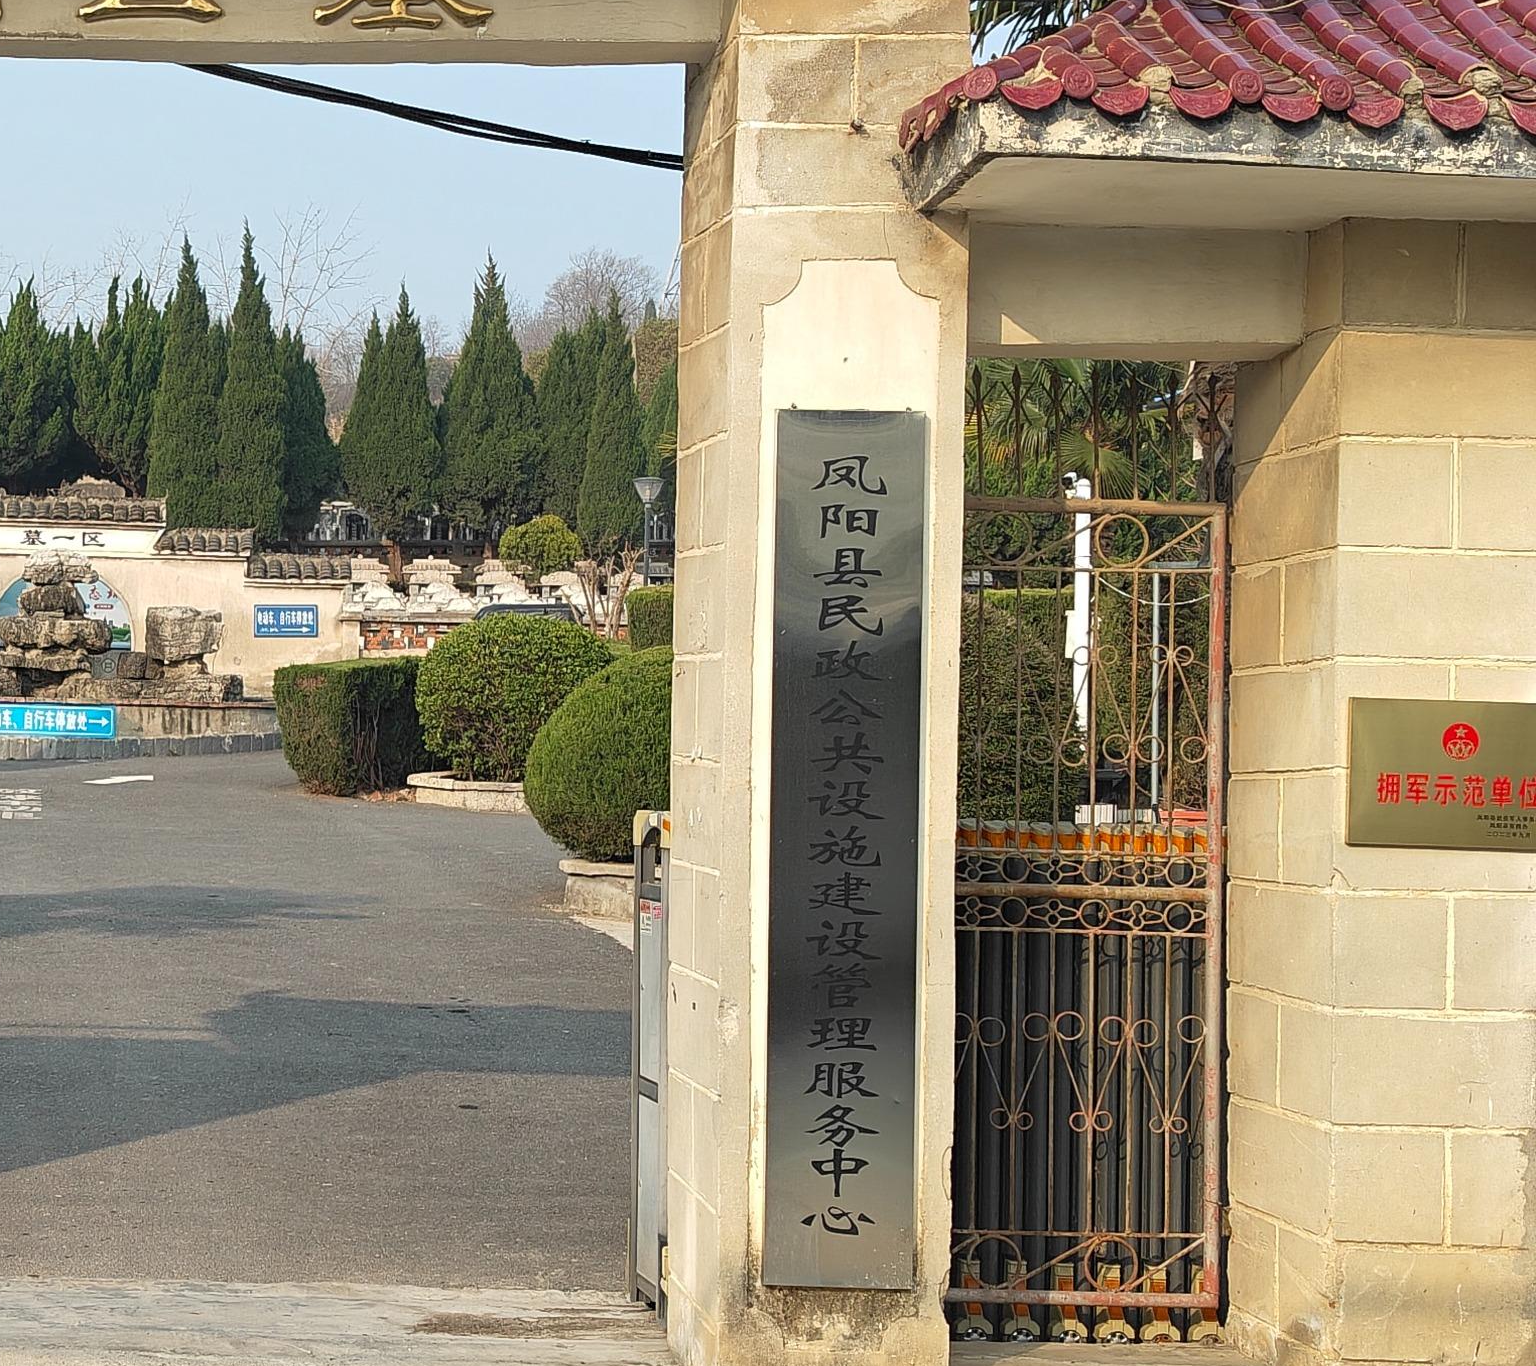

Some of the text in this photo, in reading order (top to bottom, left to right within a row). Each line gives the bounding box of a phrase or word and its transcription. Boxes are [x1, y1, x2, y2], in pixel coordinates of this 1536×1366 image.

[20, 529, 105, 547] 墓一区
[801, 455, 888, 1236] 凤阳县民政公共设施建设管理服务中心
